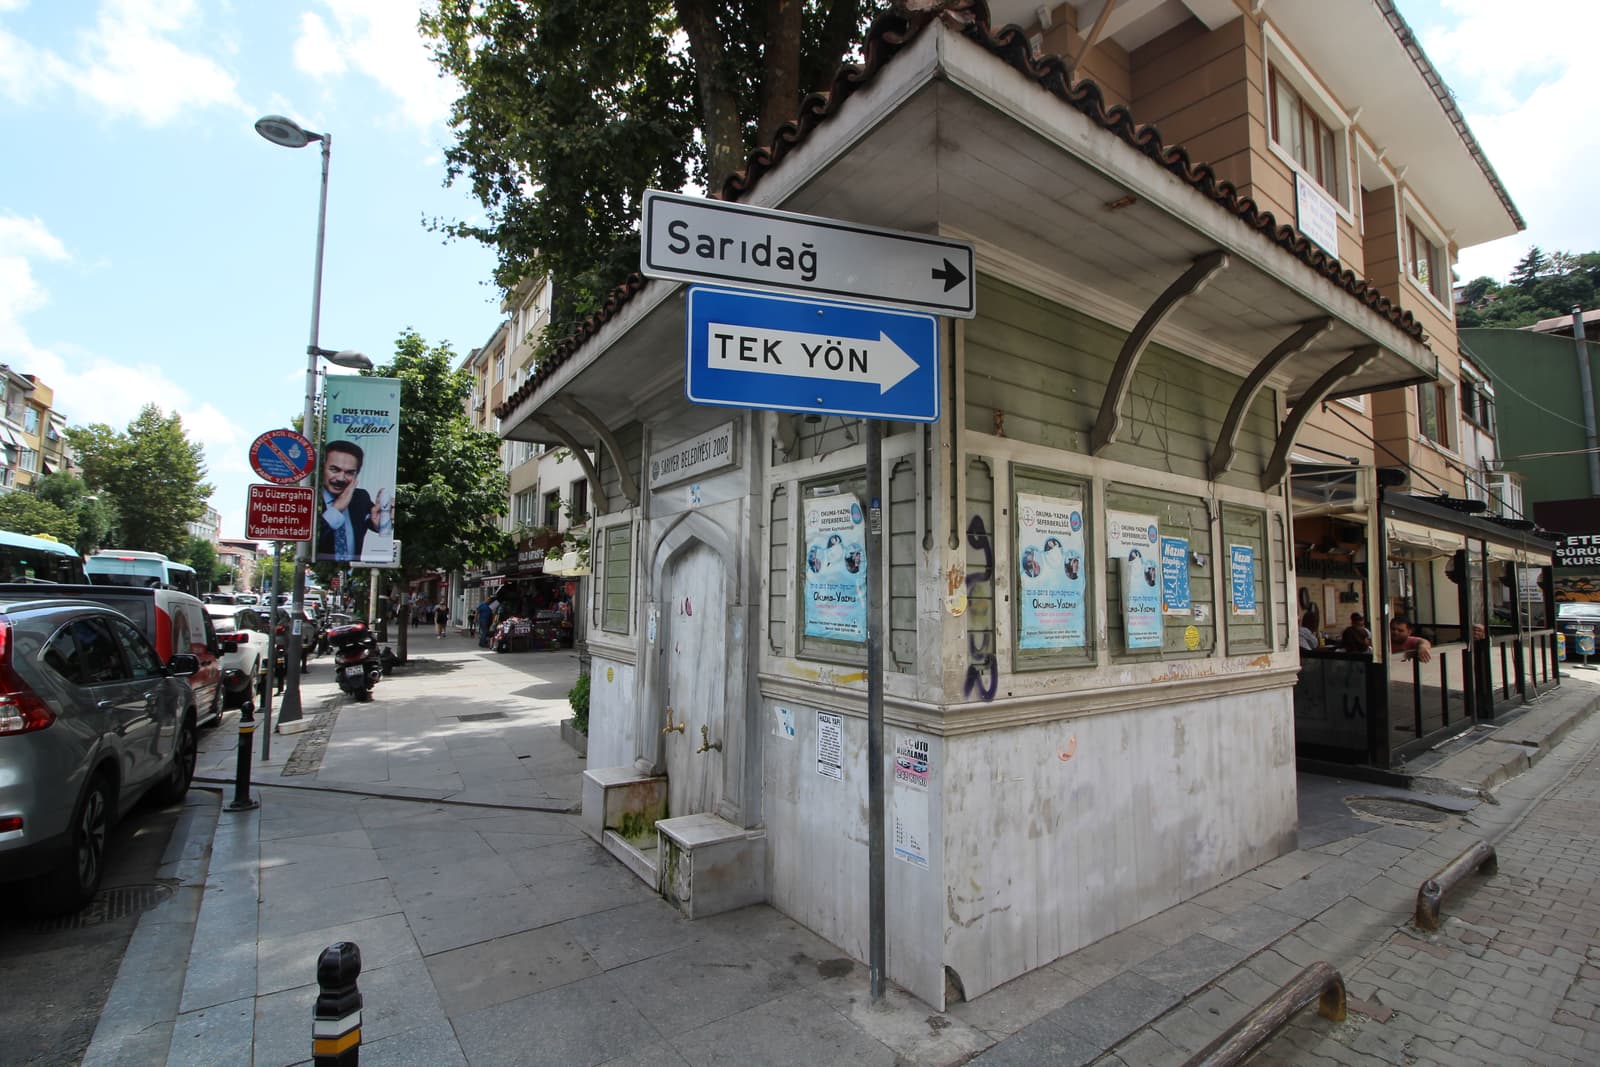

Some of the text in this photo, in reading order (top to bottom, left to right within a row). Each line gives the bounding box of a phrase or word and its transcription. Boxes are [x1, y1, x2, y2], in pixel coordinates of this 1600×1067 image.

[667, 219, 818, 282] Sarıdağ
[714, 332, 868, 374] TEK YÖN
[342, 407, 389, 417] DUŞ YETMEZ
[333, 414, 391, 425] REXONA
[345, 423, 395, 434] kullan!
[660, 454, 679, 475] SARIYER
[681, 437, 711, 469] BELEDİYESİ
[252, 488, 312, 501] Bu Güzergahta
[253, 502, 308, 513] Mobil EDS ile
[261, 513, 300, 524] Denetim
[249, 524, 311, 536] Yapılmaktadır
